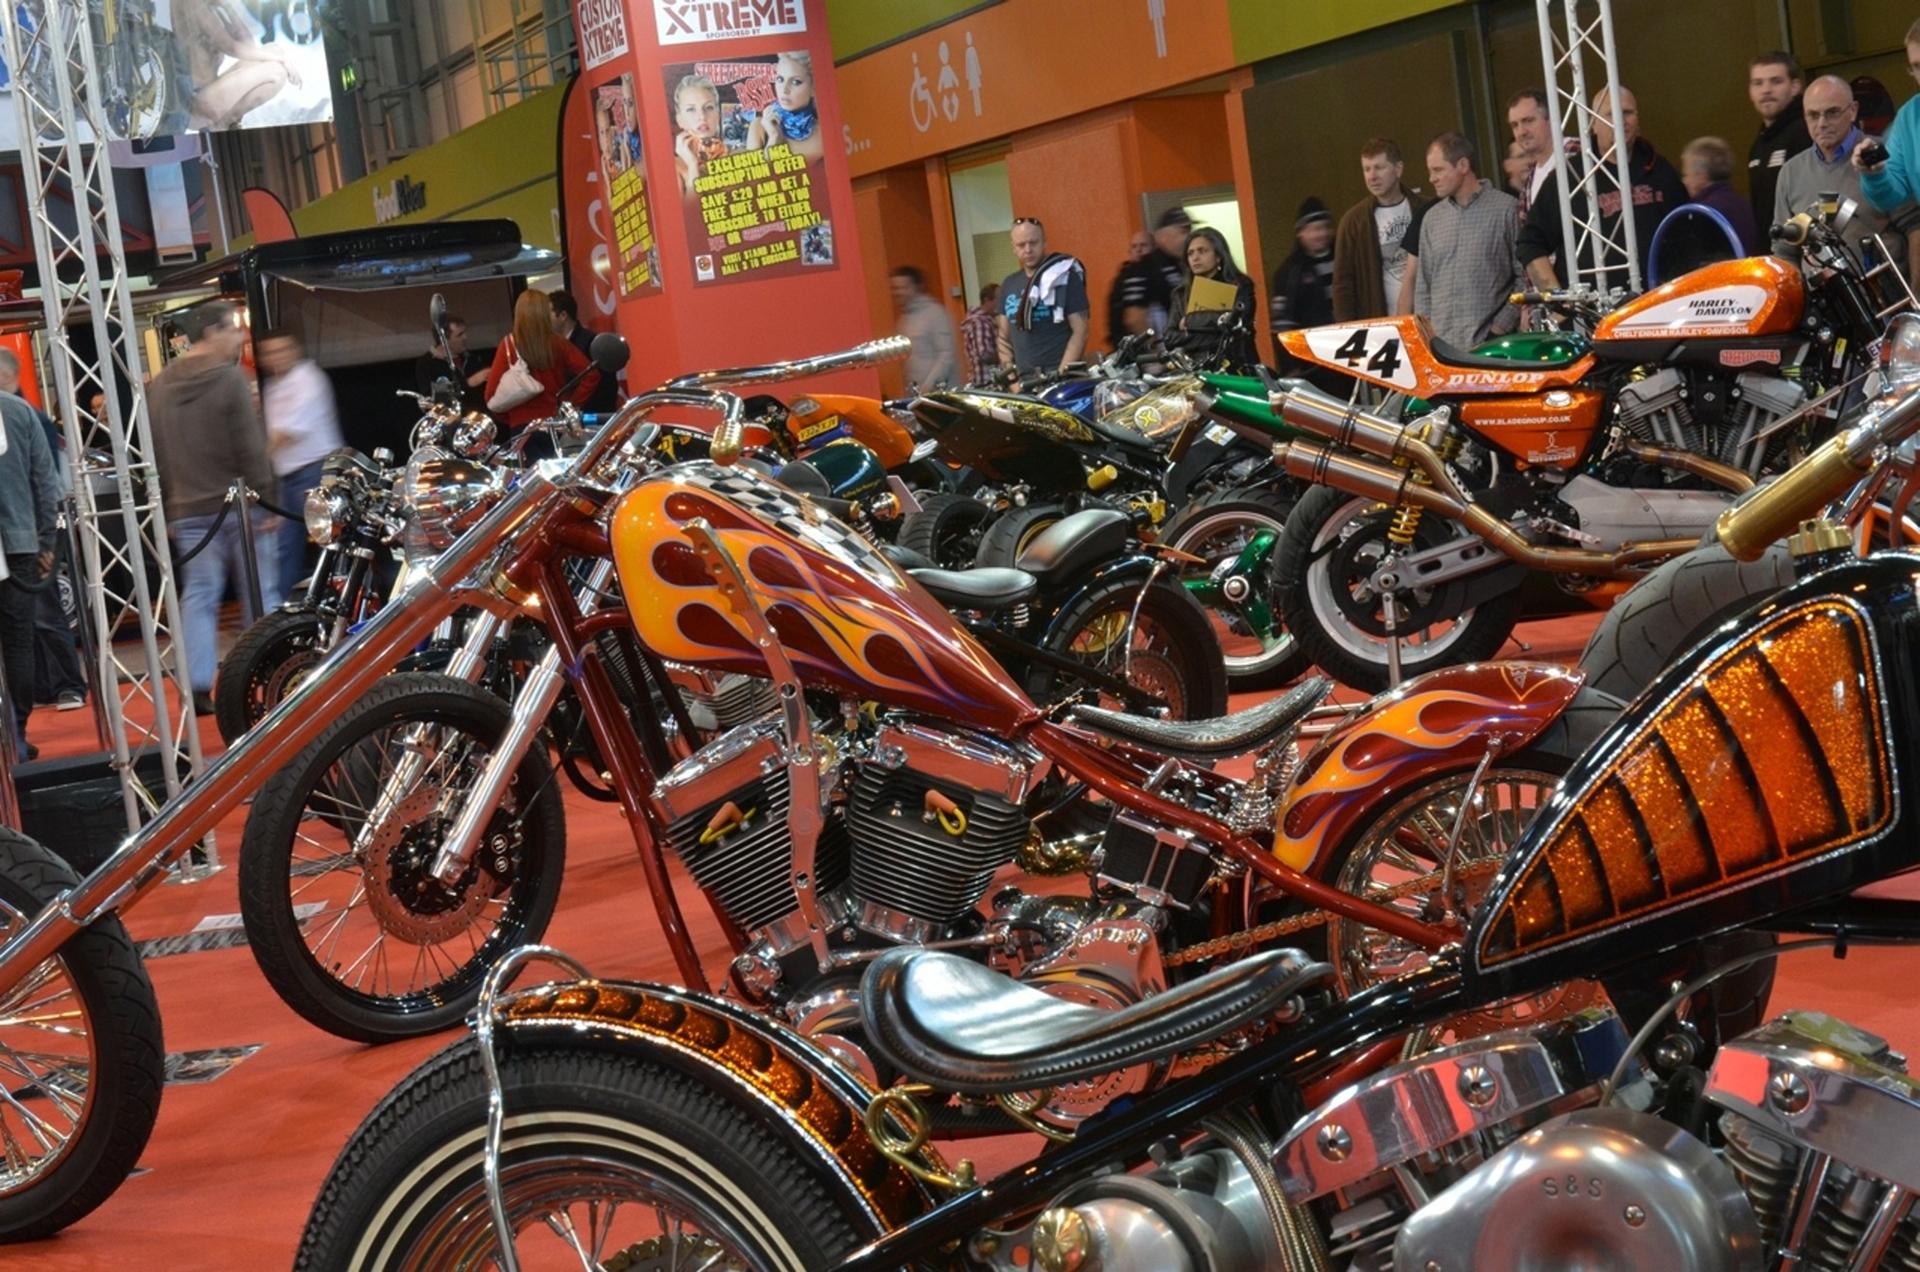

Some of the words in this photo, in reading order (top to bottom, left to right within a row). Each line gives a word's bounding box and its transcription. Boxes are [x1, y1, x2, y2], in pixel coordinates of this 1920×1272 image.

[663, 0, 798, 36] XTREME
[584, 17, 625, 61] XTREME
[694, 163, 770, 193] SUBSCRIPTION
[773, 155, 806, 175] OFFER
[707, 149, 765, 175] EXCLUSIVE
[701, 192, 727, 209] SAVE
[757, 181, 778, 197] AND
[781, 176, 797, 191] GET
[802, 173, 810, 186] A
[703, 206, 727, 223] FREE
[757, 192, 786, 210] WHEN
[790, 187, 810, 202] YOU
[708, 212, 760, 236] SUBSCRIBE
[763, 209, 776, 222] TO
[779, 201, 811, 219] EITHER
[785, 212, 821, 231] TODAY!
[1695, 307, 1752, 316] DAVIDSON
[1614, 328, 1669, 338] CHELTENHAM
[1335, 329, 1401, 379] 44
[1449, 373, 1546, 386] DUNLOP
[1474, 415, 1571, 426] WWW.BLADEGROUP.CO.UK
